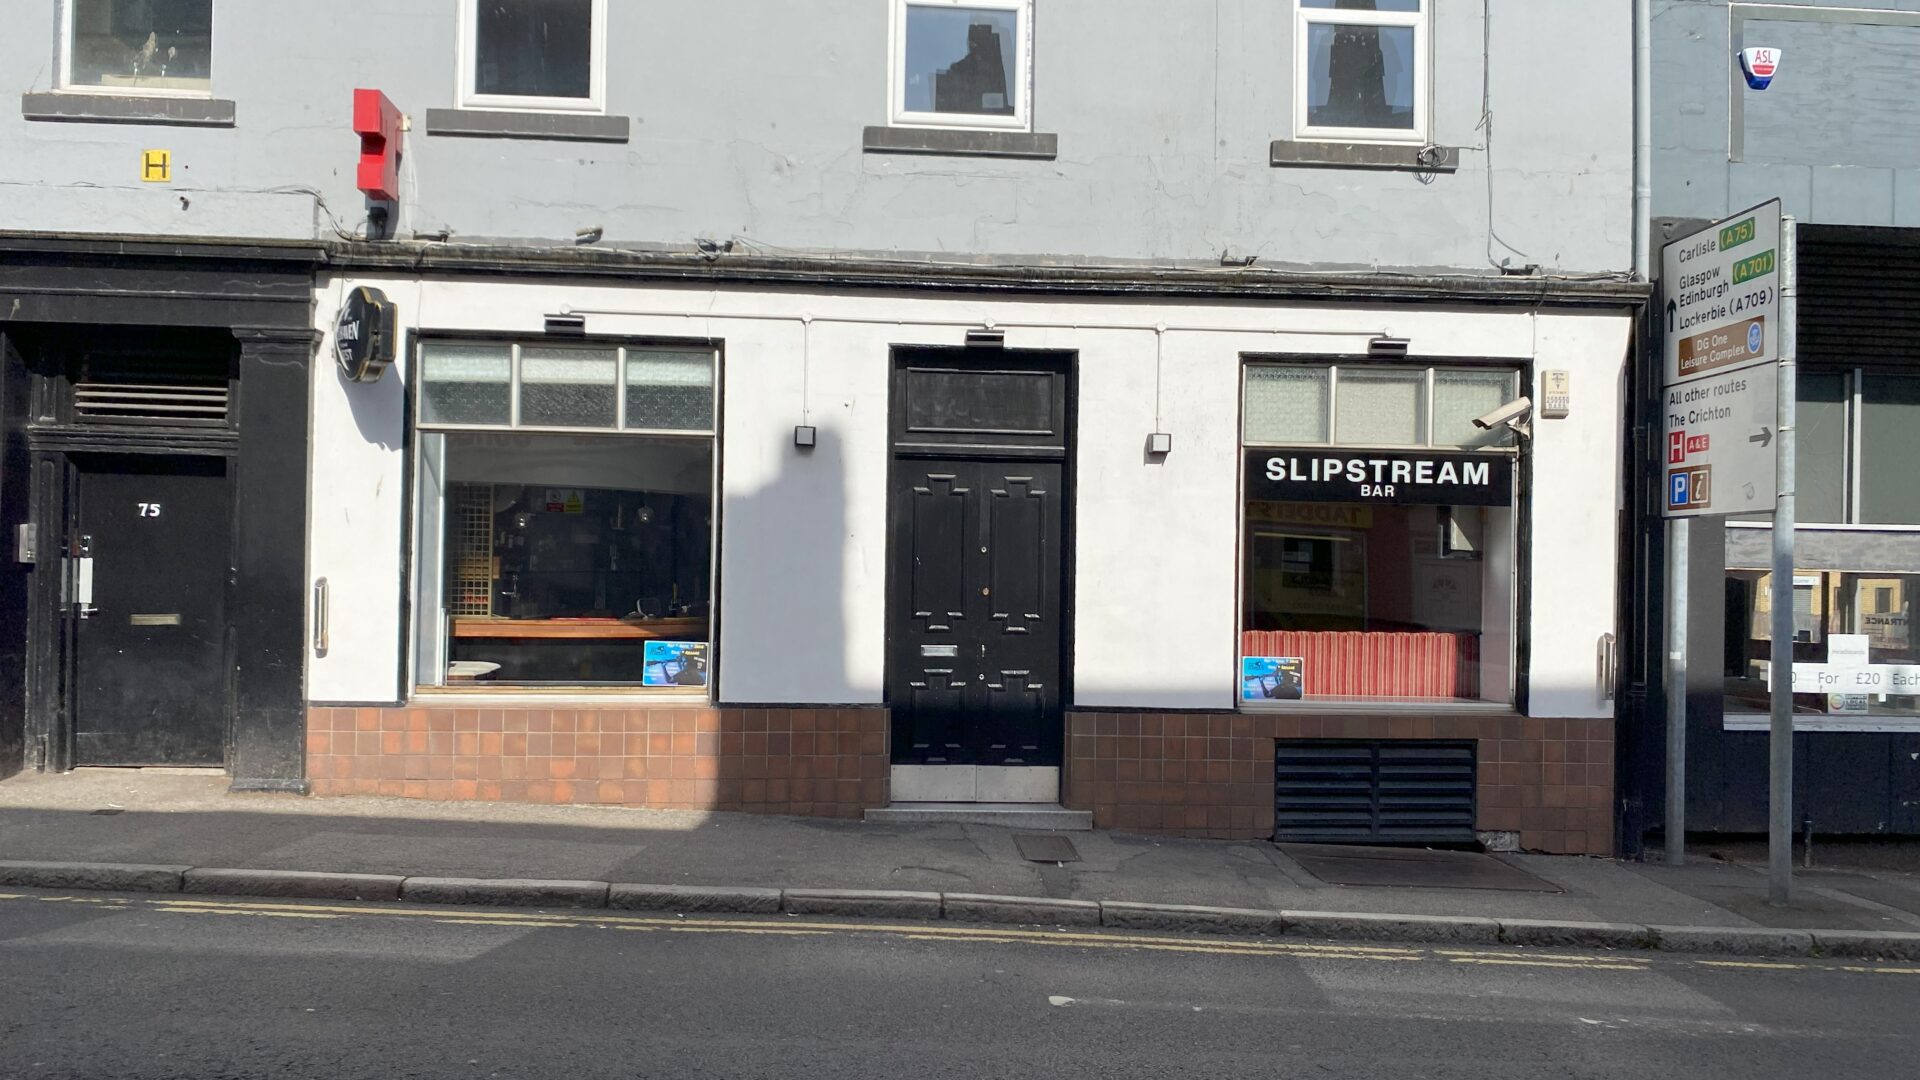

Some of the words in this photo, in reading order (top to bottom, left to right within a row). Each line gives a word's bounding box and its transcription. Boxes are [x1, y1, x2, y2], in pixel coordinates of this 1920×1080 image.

[1755, 50, 1773, 63] ASL
[145, 153, 166, 178] H
[1679, 240, 1716, 263] Carlisle
[1720, 220, 1754, 248] (A75)
[1680, 267, 1720, 289] Glasgow
[1734, 252, 1773, 282] (A701)
[1680, 280, 1729, 307] Edinburgh
[1680, 305, 1726, 330] Lockerbie
[1729, 286, 1773, 315] (A709)
[1696, 337, 1710, 351] DG
[1711, 334, 1728, 347] One
[1681, 355, 1708, 369] Leisure
[1709, 345, 1745, 362] Complex
[1669, 391, 1682, 406] All
[1684, 387, 1710, 403] other
[1713, 379, 1747, 399] routes
[1669, 414, 1685, 428] The
[1688, 406, 1731, 424] Crichton
[1670, 433, 1683, 462] H
[1688, 437, 1708, 450] A&E
[1265, 457, 1490, 486] SLIPSTREAM
[1360, 484, 1395, 497] BAR
[1674, 476, 1686, 503] P
[138, 503, 161, 517] 75
[1818, 671, 1840, 684] For
[1856, 672, 1880, 685] £20
[1892, 672, 1920, 686] Each
